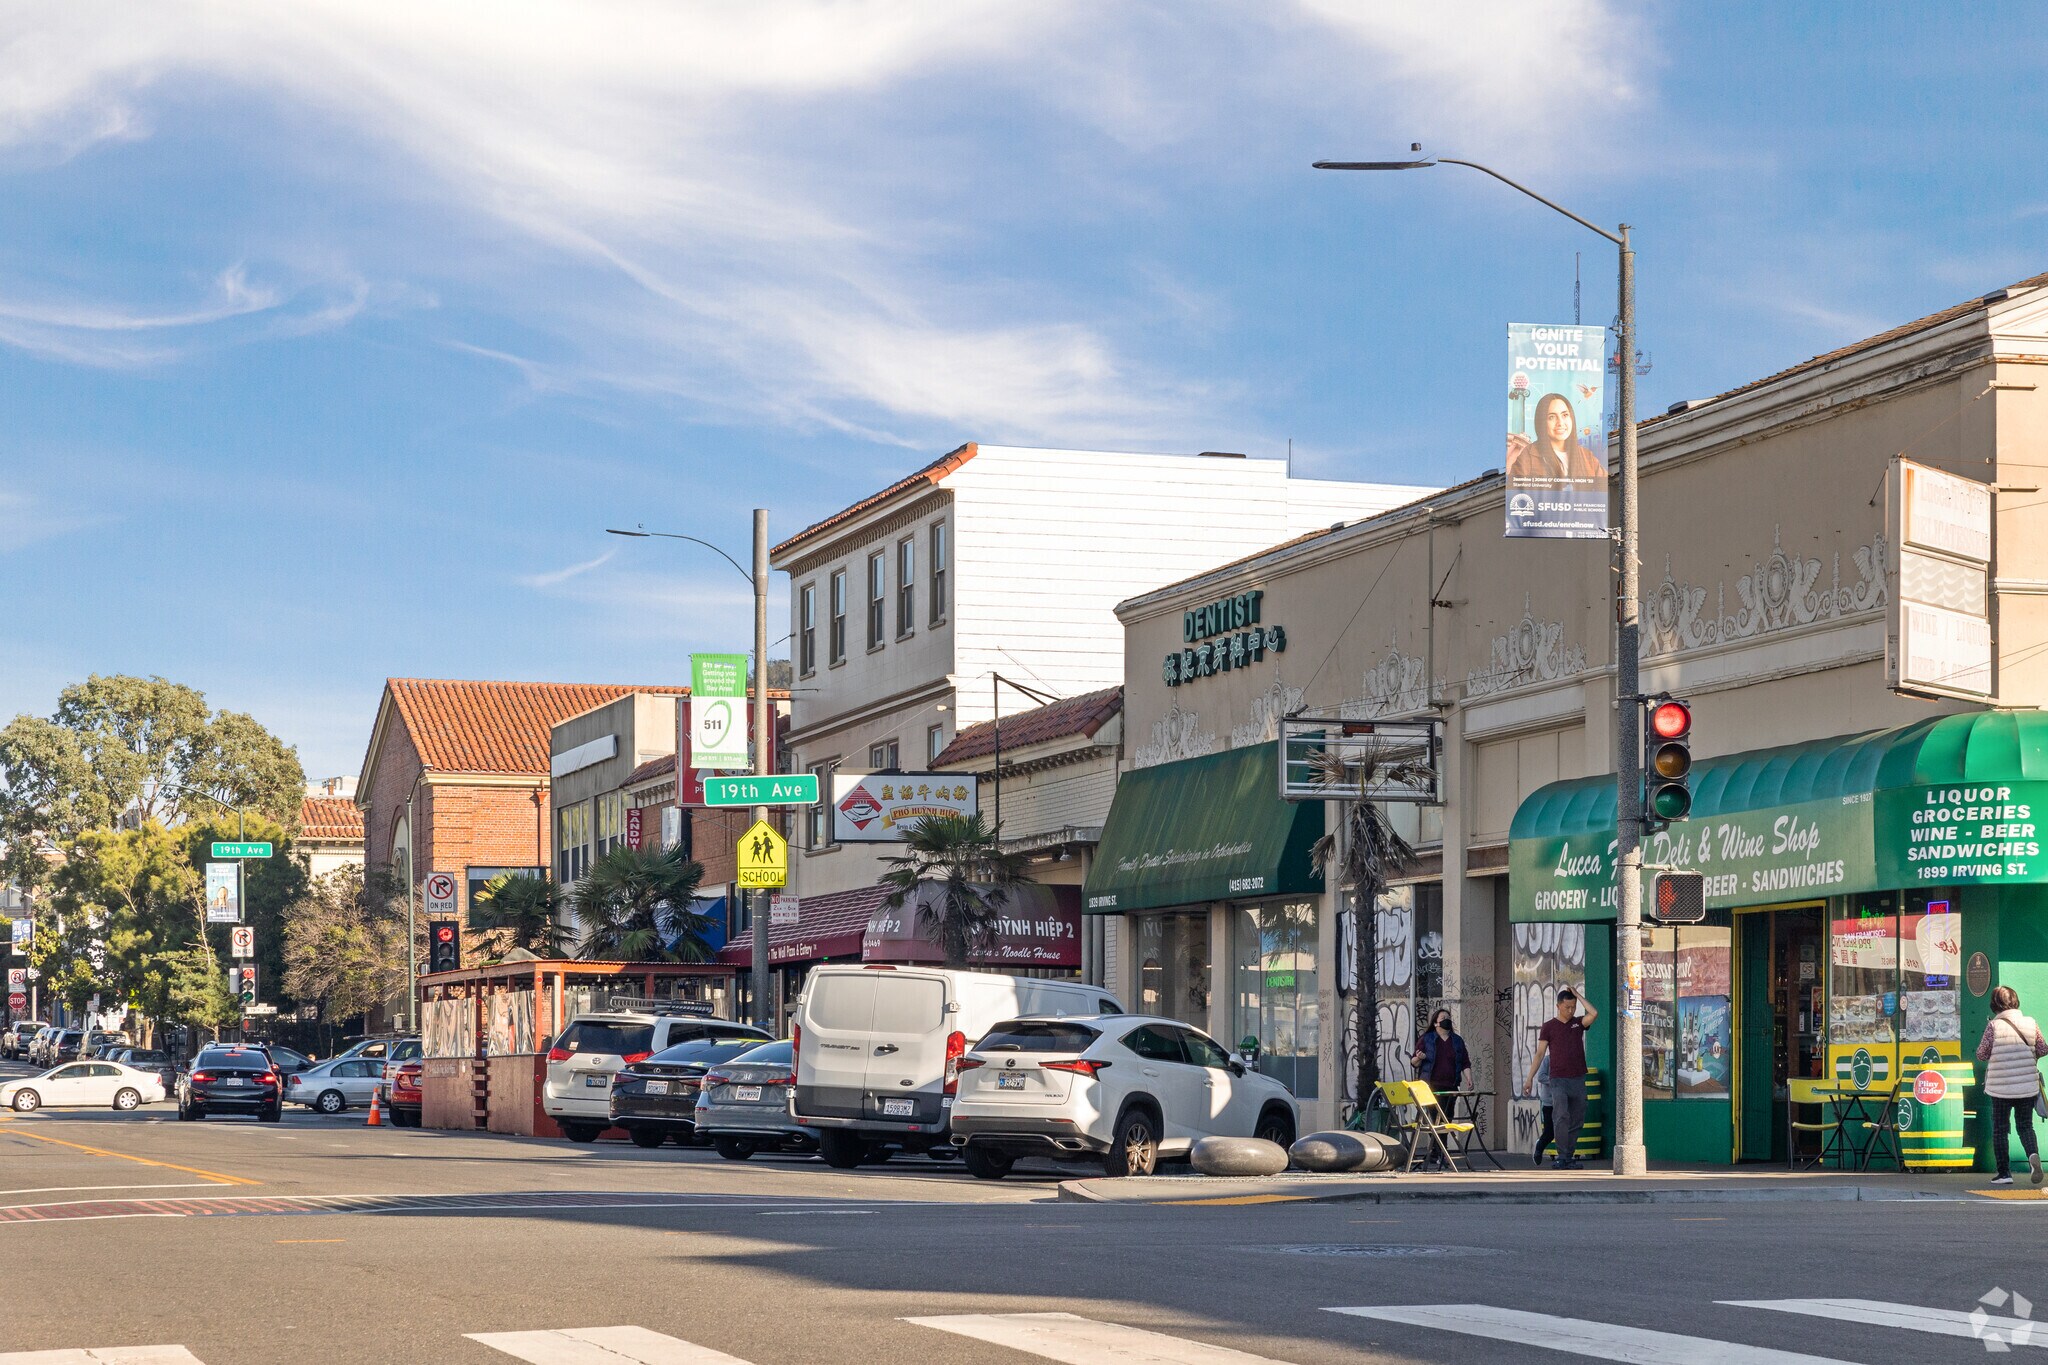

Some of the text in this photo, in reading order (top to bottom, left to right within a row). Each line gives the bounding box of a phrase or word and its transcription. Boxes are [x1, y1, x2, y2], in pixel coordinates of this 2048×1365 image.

[1531, 328, 1583, 342] IGNITE
[1534, 342, 1579, 356] YOUR
[1515, 356, 1602, 372] POTENTIAL
[1538, 503, 1571, 512] SFUSD
[1184, 590, 1263, 643] DENTIST
[706, 685, 718, 693] Bay
[704, 720, 722, 730] 511
[721, 782, 802, 799] 19th Ave
[1927, 787, 2010, 805] LIQUOR
[1842, 793, 1872, 805] SINCE 1927
[1913, 805, 2030, 824] GROCERIES
[630, 810, 640, 852] SANDWI
[1911, 826, 1958, 842] WINE
[1981, 824, 2036, 838] BEER
[220, 846, 264, 854] 19th Ave
[1554, 815, 1820, 881] Lucca Fd Deli & Wine Shop
[1908, 842, 2040, 861] SANDWICHES
[742, 871, 783, 884] SCHOOL
[1918, 863, 2028, 879] 1899 IRVING ST.
[1229, 876, 1264, 892] (415) 682-2072
[1535, 889, 1588, 910] GROCERY
[1600, 884, 1644, 908] LIQR
[1705, 874, 1738, 897] BEER
[1752, 860, 1844, 892] SANDWICHES
[772, 895, 780, 904] NO
[894, 920, 900, 932] 2
[1035, 916, 1064, 940] HIỆP
[1066, 922, 1074, 938] 2
[1002, 945, 1032, 958] Noodle
[1034, 946, 1060, 960] House
[1918, 1080, 1938, 1088] Pliny
